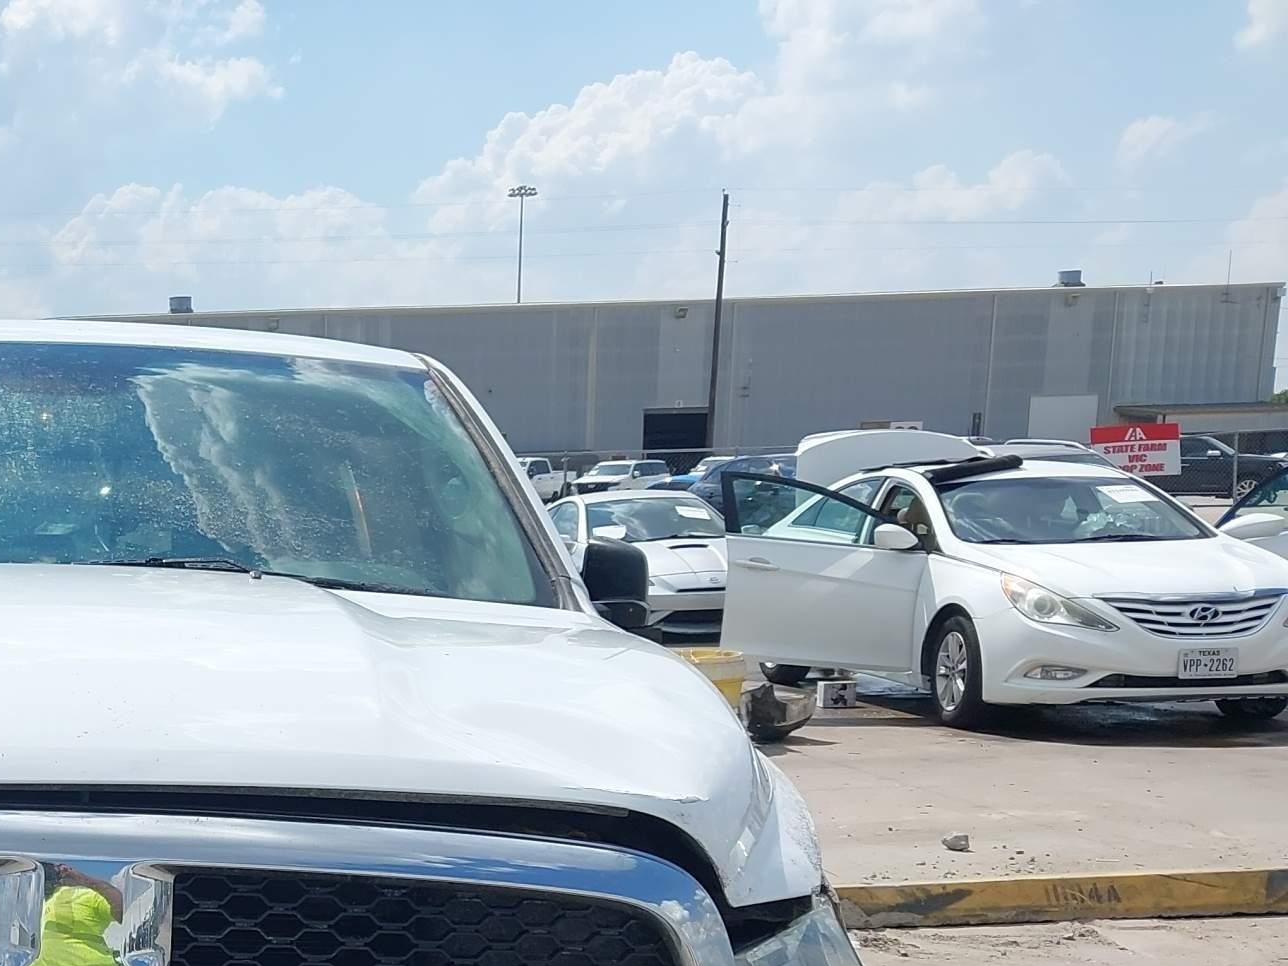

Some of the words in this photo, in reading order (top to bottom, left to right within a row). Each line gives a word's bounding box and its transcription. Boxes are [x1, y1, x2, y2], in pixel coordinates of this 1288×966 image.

[1103, 444, 1136, 455] STATE
[1138, 442, 1168, 452] FARM
[1127, 454, 1148, 463] VIC
[1138, 463, 1166, 472] ZONE
[1199, 649, 1221, 657] TEXAS
